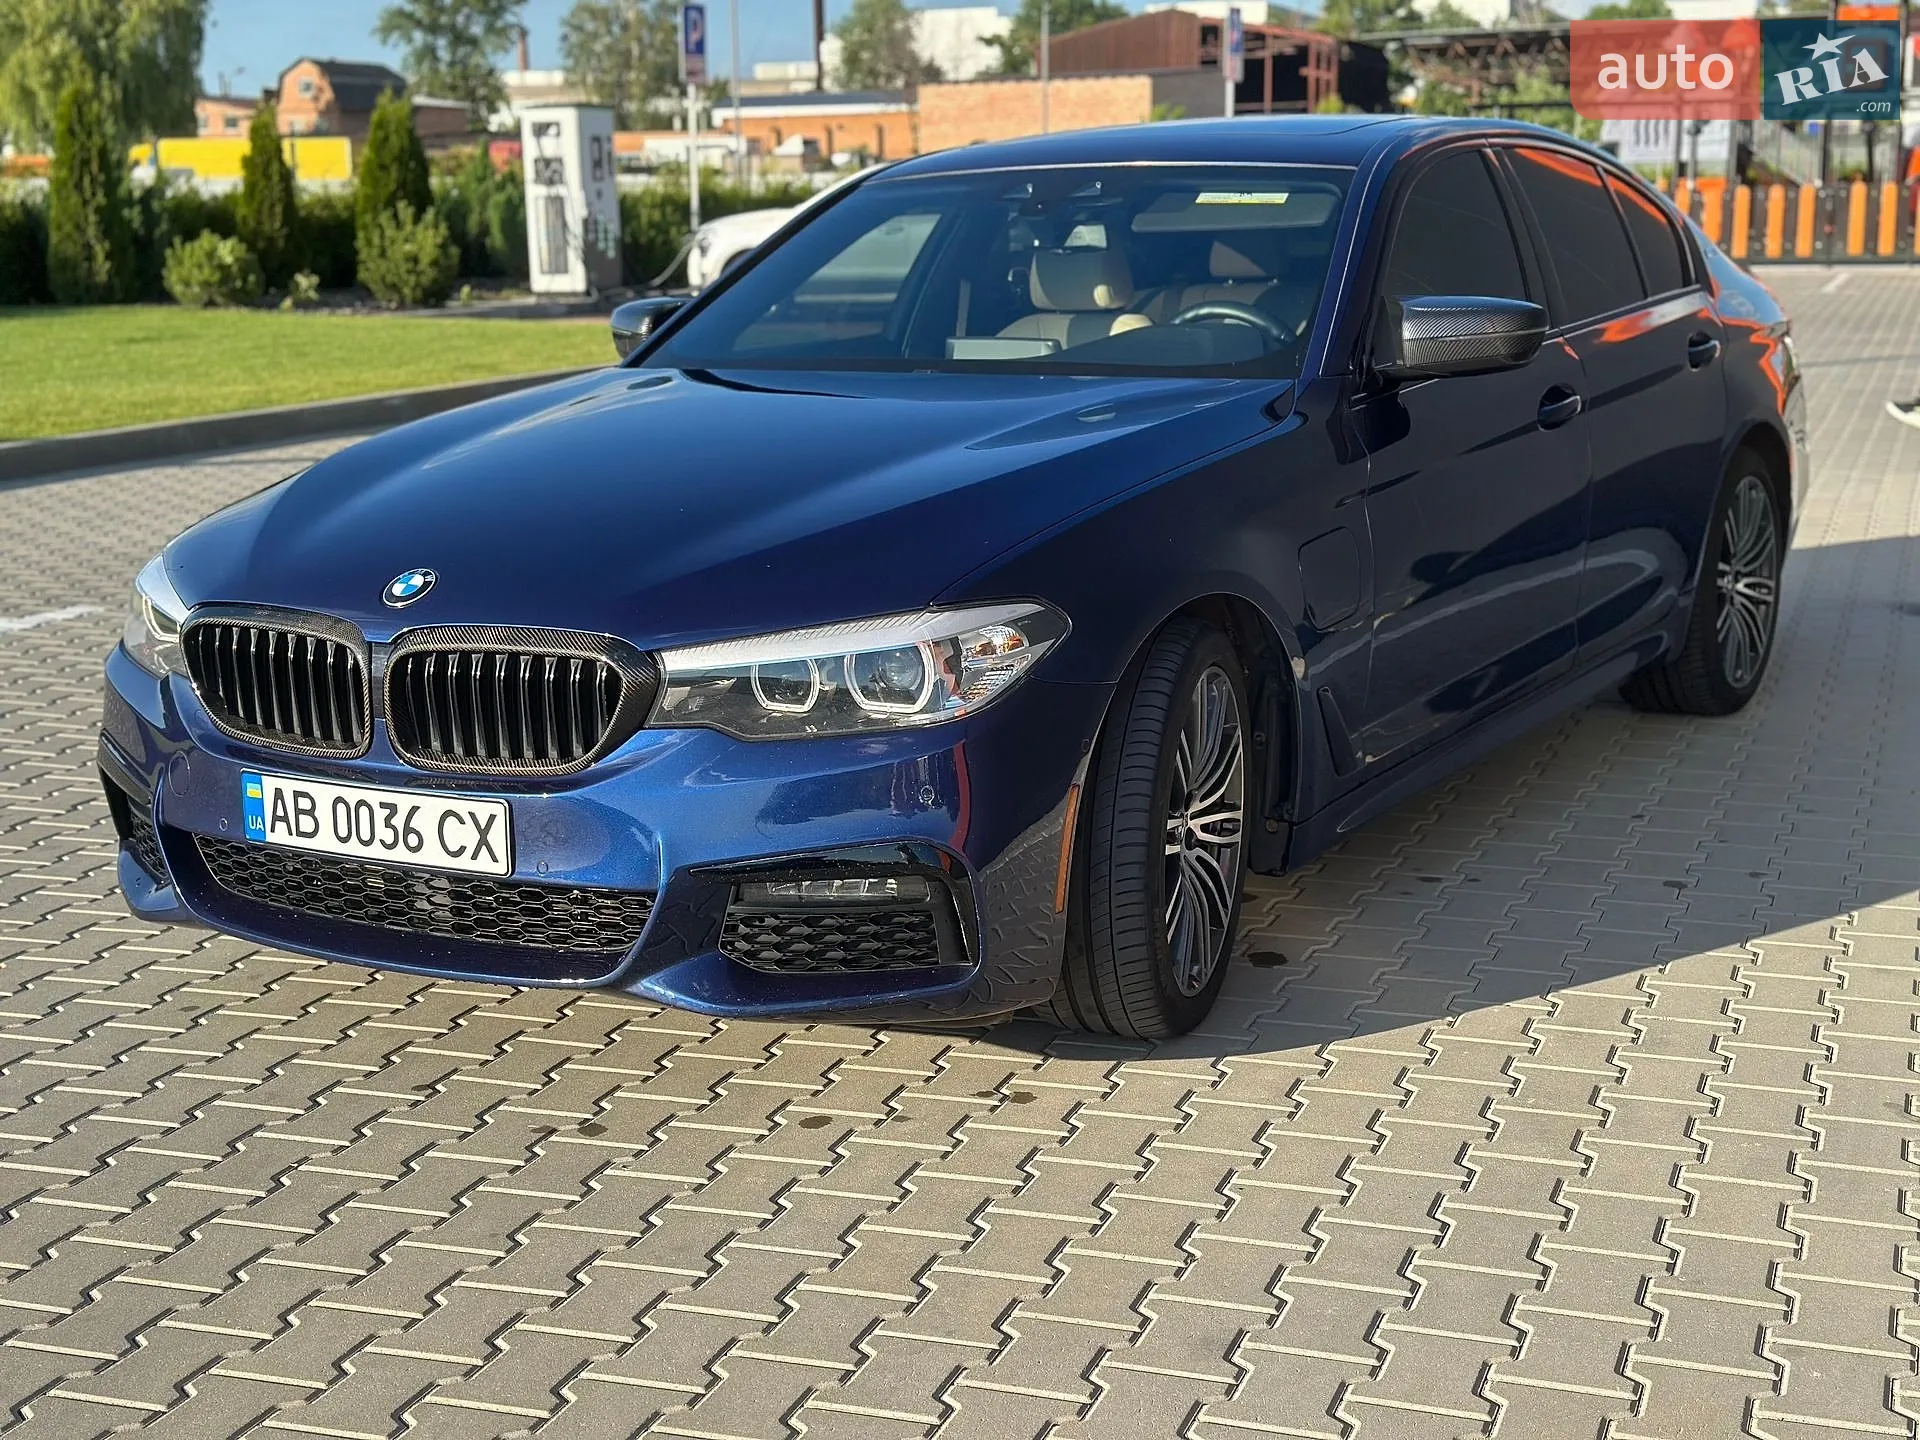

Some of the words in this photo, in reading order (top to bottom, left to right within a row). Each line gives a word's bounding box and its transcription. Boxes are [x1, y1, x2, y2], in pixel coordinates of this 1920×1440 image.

[248, 815, 265, 832] UA
[270, 786, 321, 839] AB
[331, 795, 425, 854] 0036
[437, 809, 500, 864] CX
